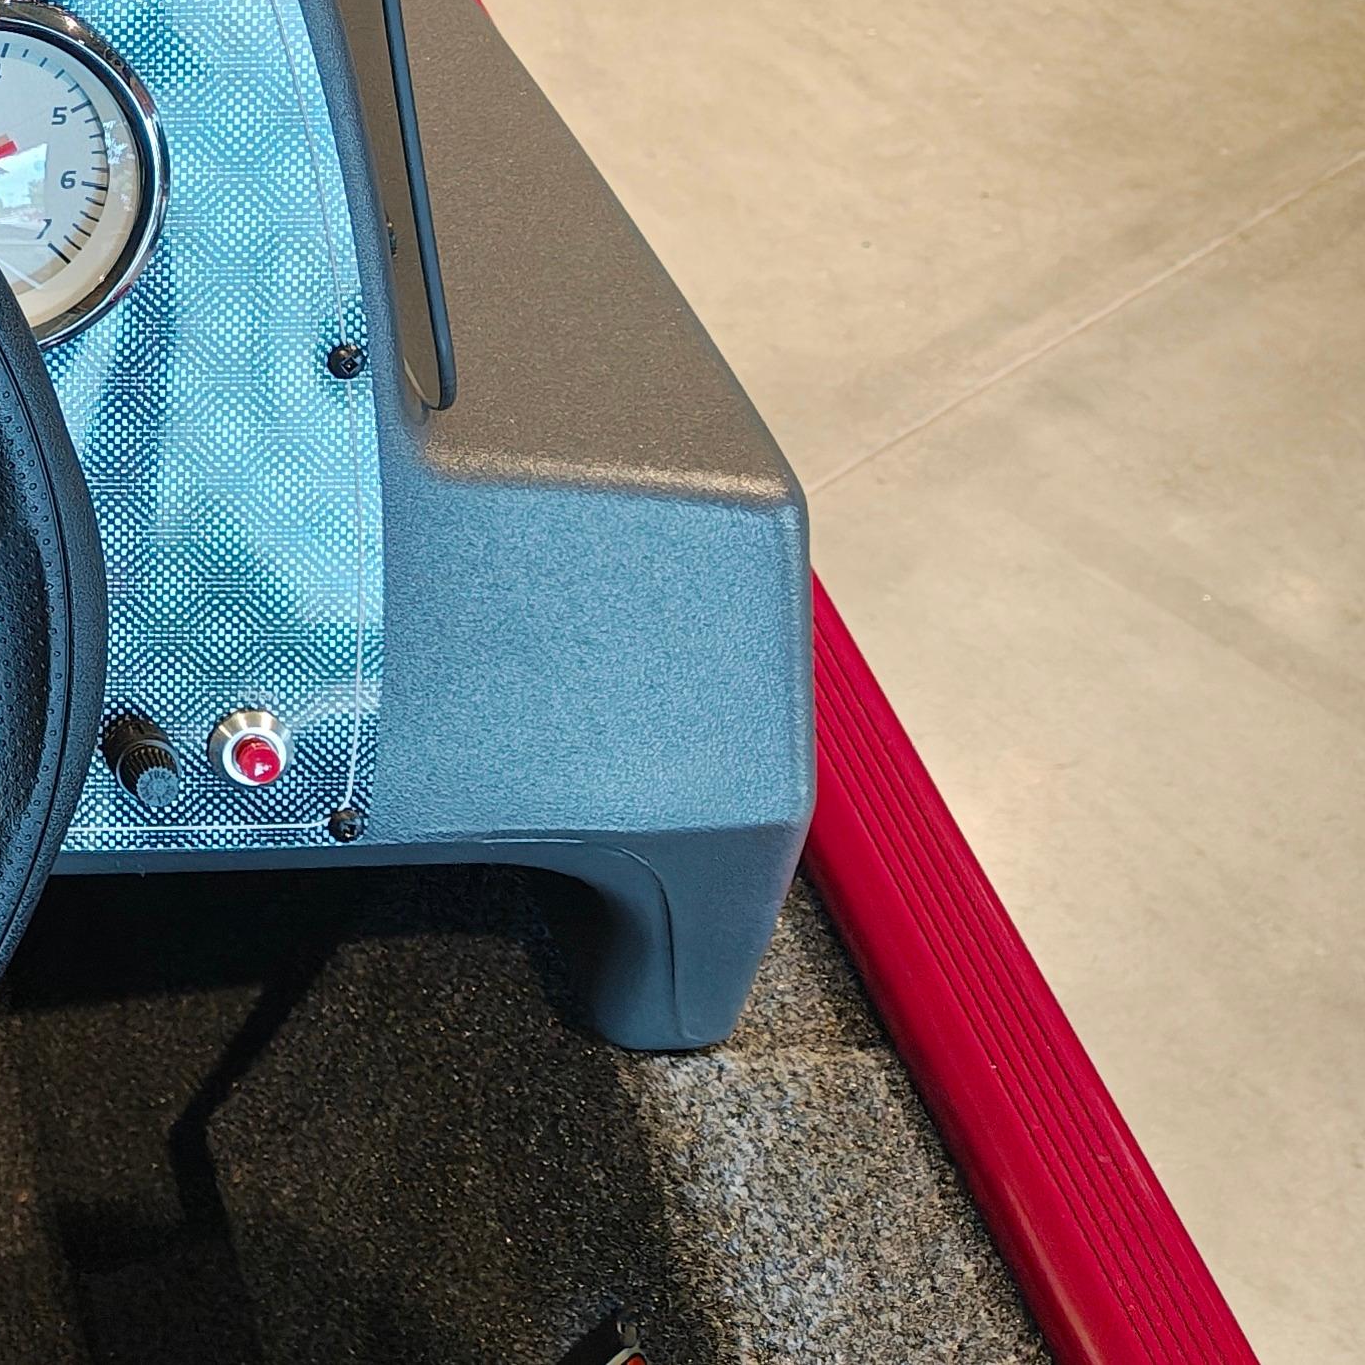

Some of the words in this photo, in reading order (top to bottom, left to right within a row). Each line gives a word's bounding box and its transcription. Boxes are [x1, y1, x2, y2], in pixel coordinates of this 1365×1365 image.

[51, 106, 68, 125] 5
[60, 170, 77, 190] 6
[36, 218, 53, 240] 7
